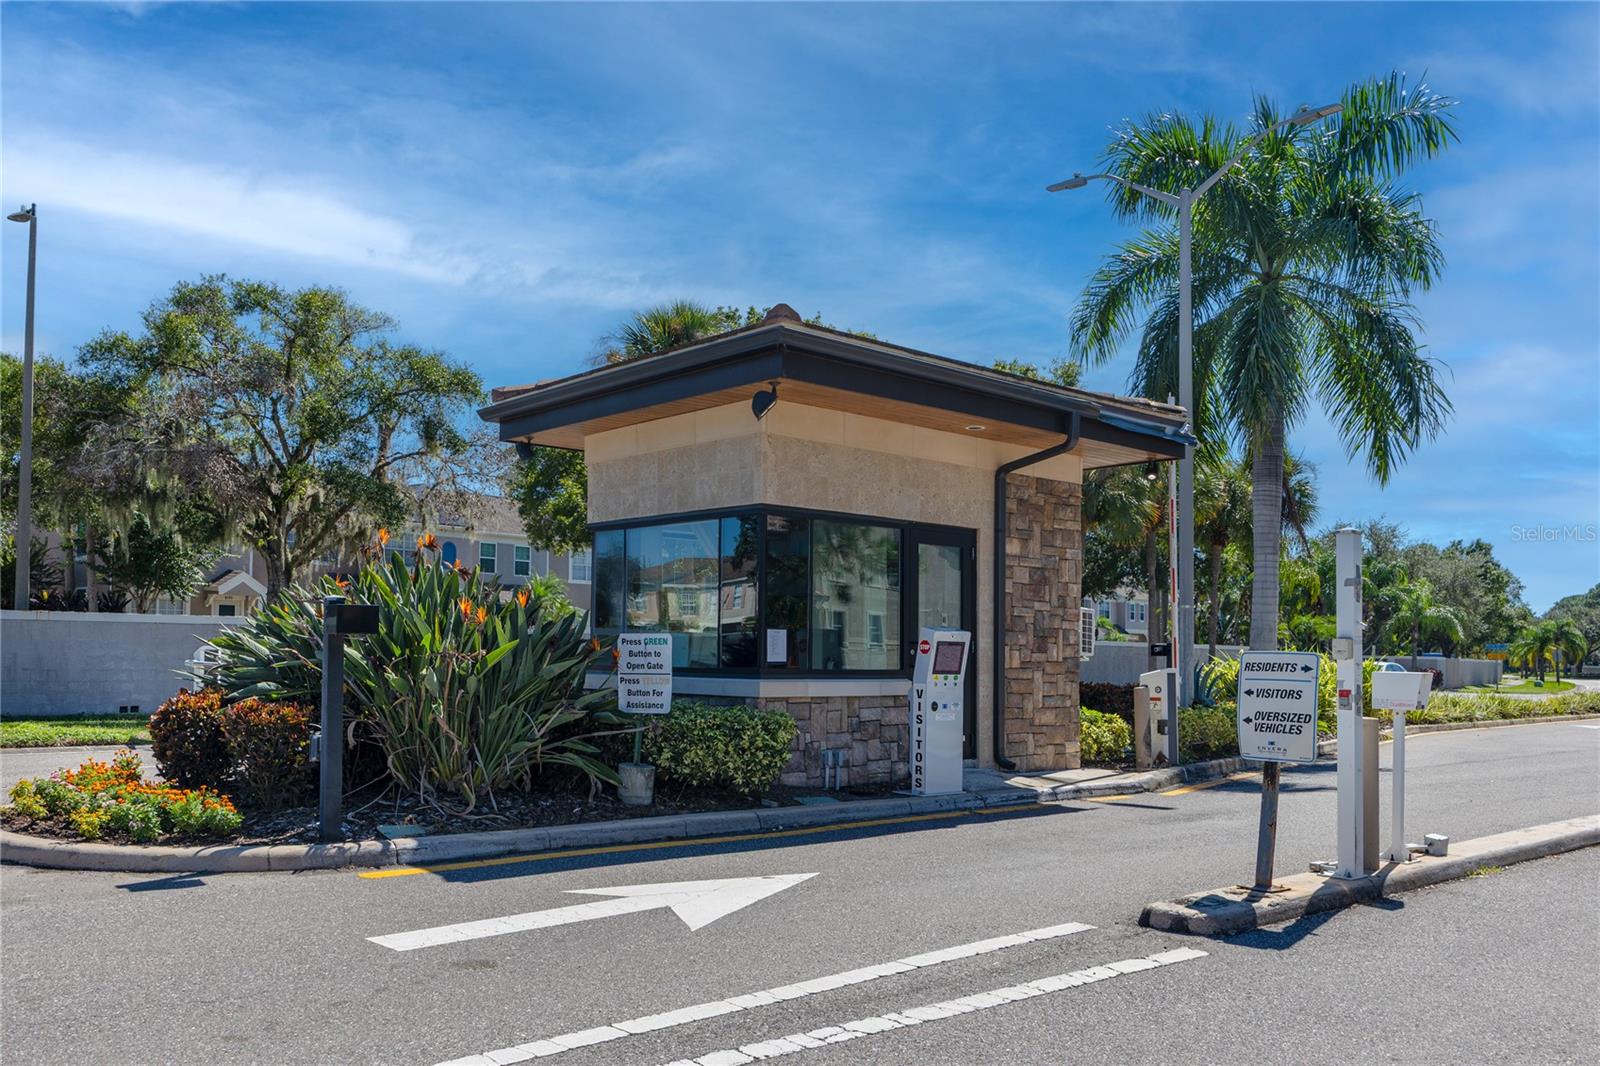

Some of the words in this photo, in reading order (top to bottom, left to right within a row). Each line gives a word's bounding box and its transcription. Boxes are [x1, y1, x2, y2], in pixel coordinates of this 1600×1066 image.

[621, 638, 642, 646] Press
[644, 638, 668, 646] GREEN
[628, 650, 653, 658] Button
[654, 650, 662, 658] to
[626, 662, 645, 671] Open
[647, 662, 664, 670] Gate
[1244, 662, 1298, 673] RESIDENTS
[620, 677, 640, 685] Press
[627, 689, 651, 697] Button
[652, 689, 664, 697] For
[1255, 688, 1303, 700] VISITORS
[626, 701, 665, 710] Assistance
[1254, 711, 1312, 724] OVERSIZED
[1254, 722, 1303, 736] VEHICLES
[915, 689, 924, 788] VISITORS
